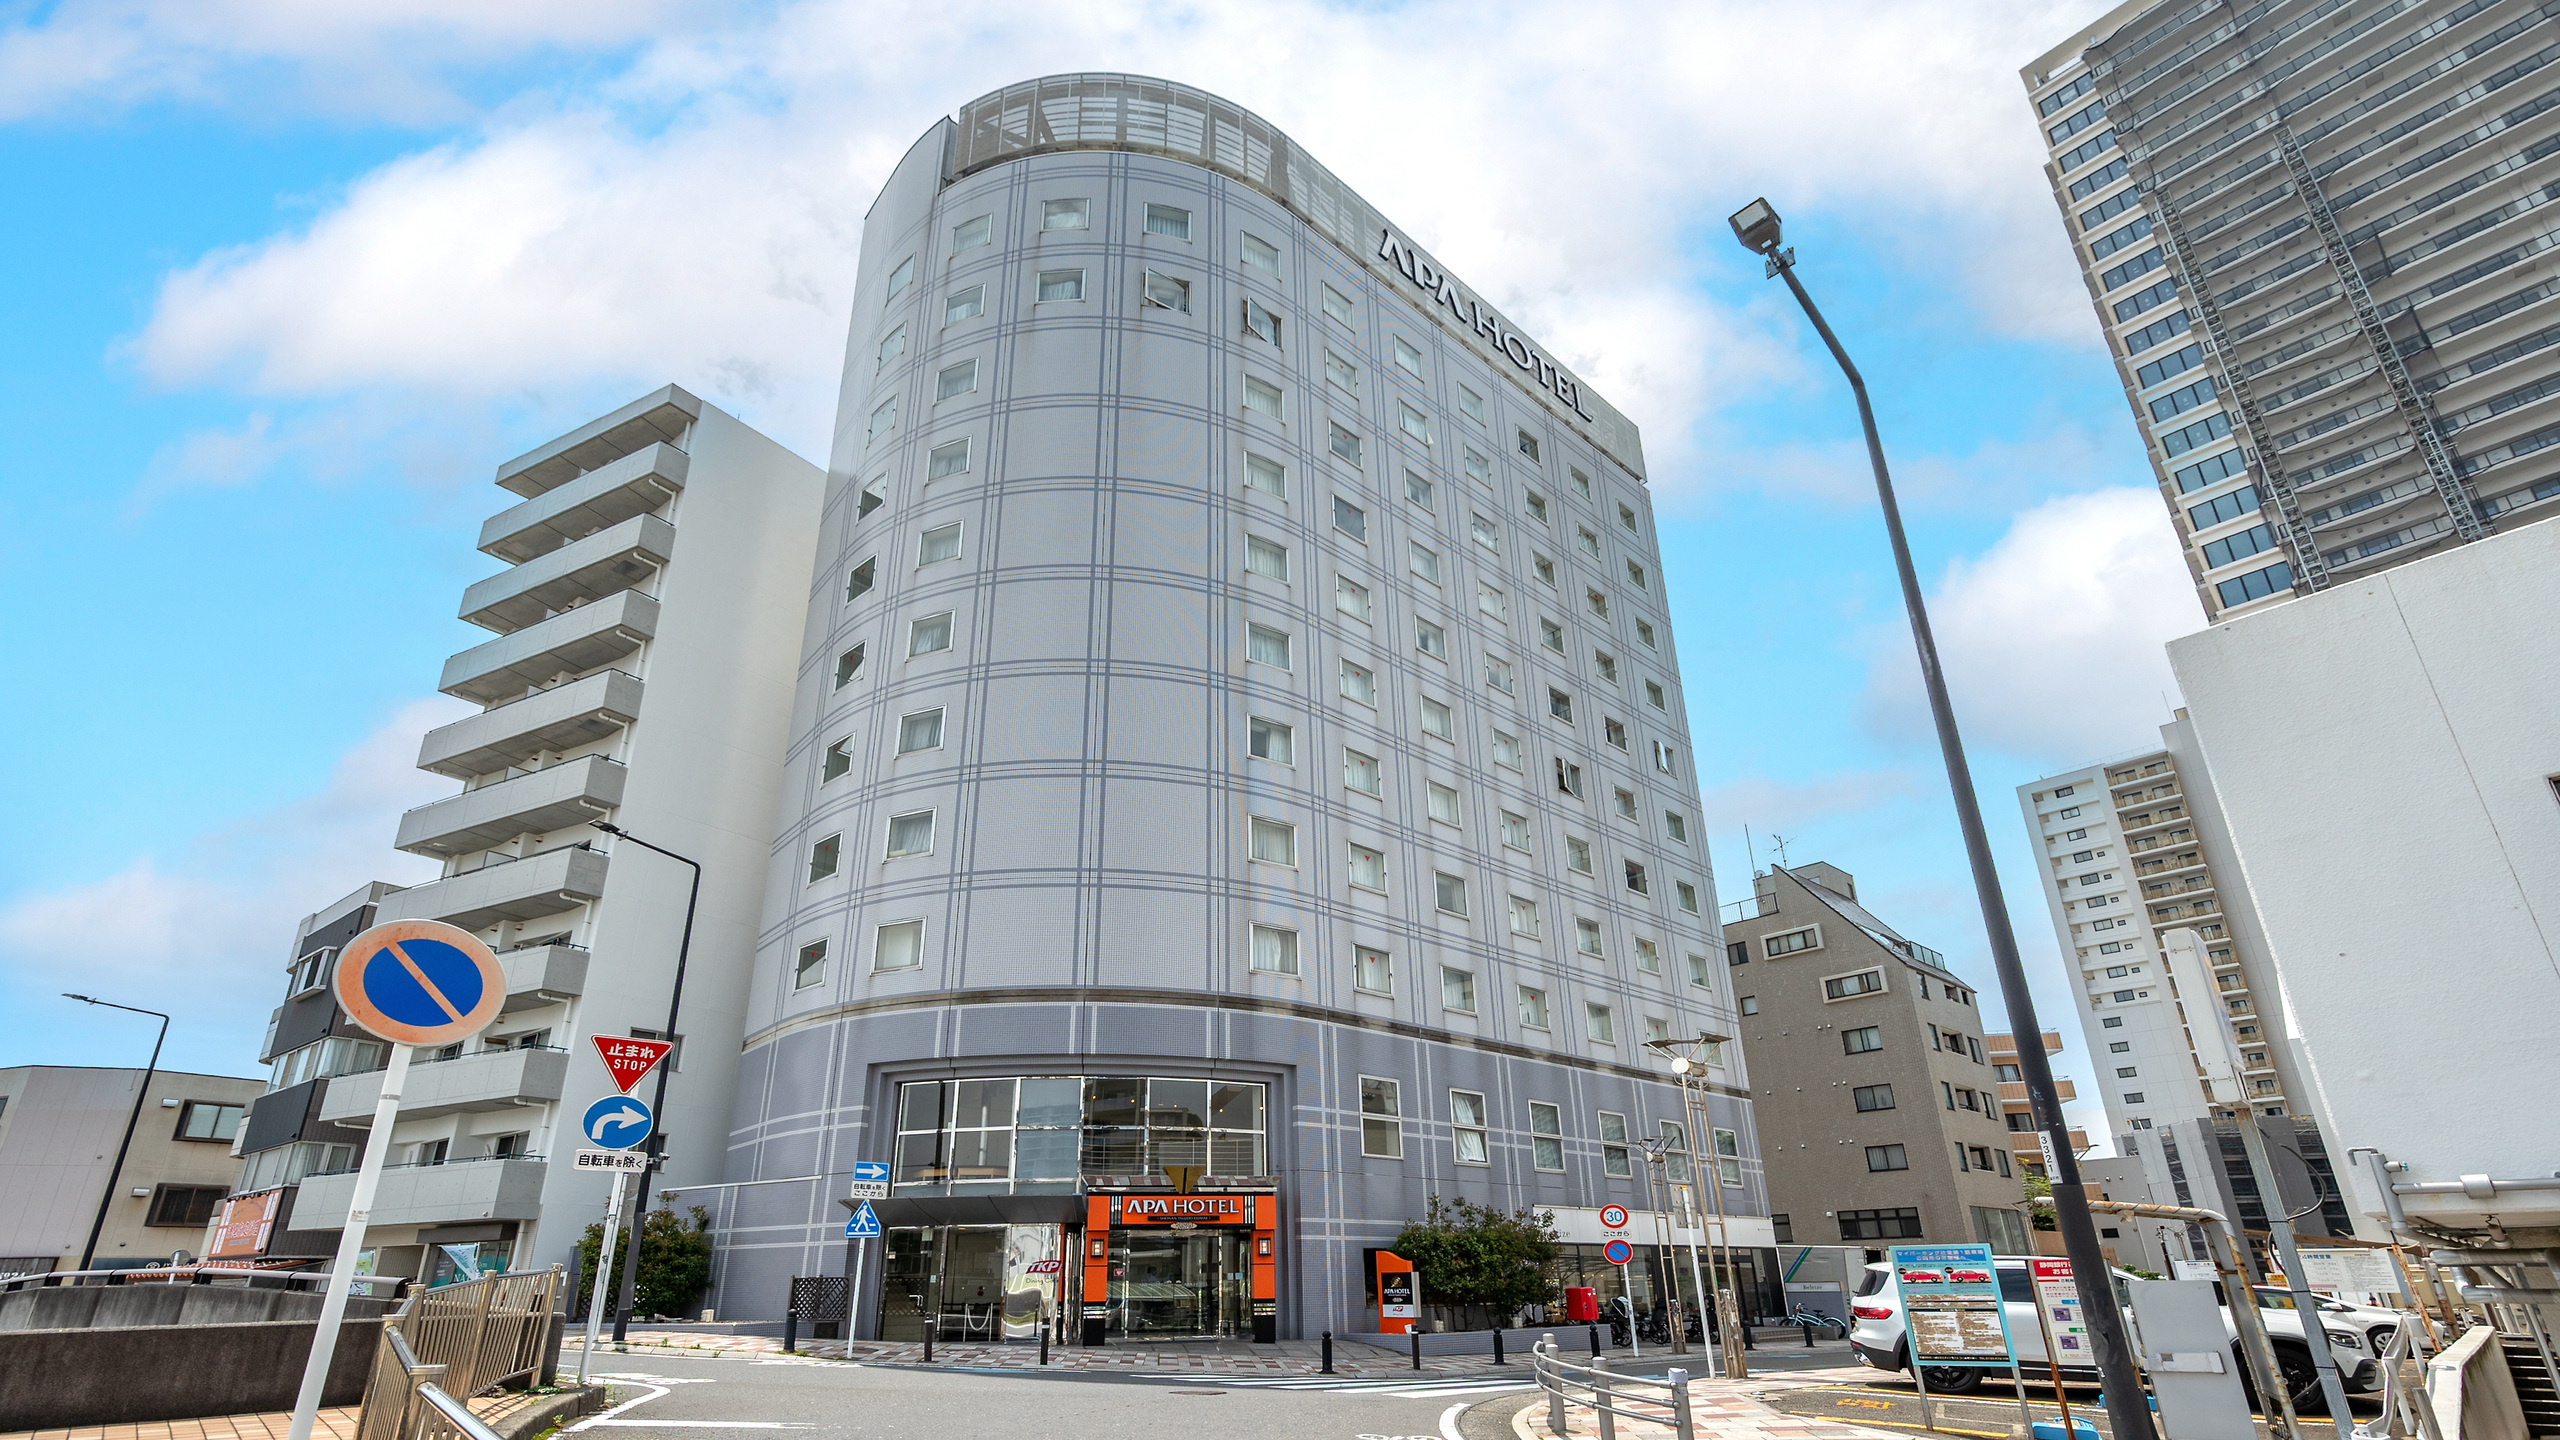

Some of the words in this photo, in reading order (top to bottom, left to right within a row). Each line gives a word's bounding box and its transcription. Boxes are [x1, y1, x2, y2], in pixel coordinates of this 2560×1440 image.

[1378, 228, 1468, 324] APA
[1470, 299, 1594, 423] HOTEL
[606, 1043, 656, 1059] 止まれ
[613, 1058, 647, 1071] STOP
[578, 1154, 642, 1169] 自転車を除く
[2040, 1135, 2053, 1173] 3321
[1127, 1199, 1169, 1214] APA
[1173, 1199, 1240, 1214] HOTEL
[1606, 1210, 1623, 1222] 30
[1029, 1261, 1060, 1272] TKP
